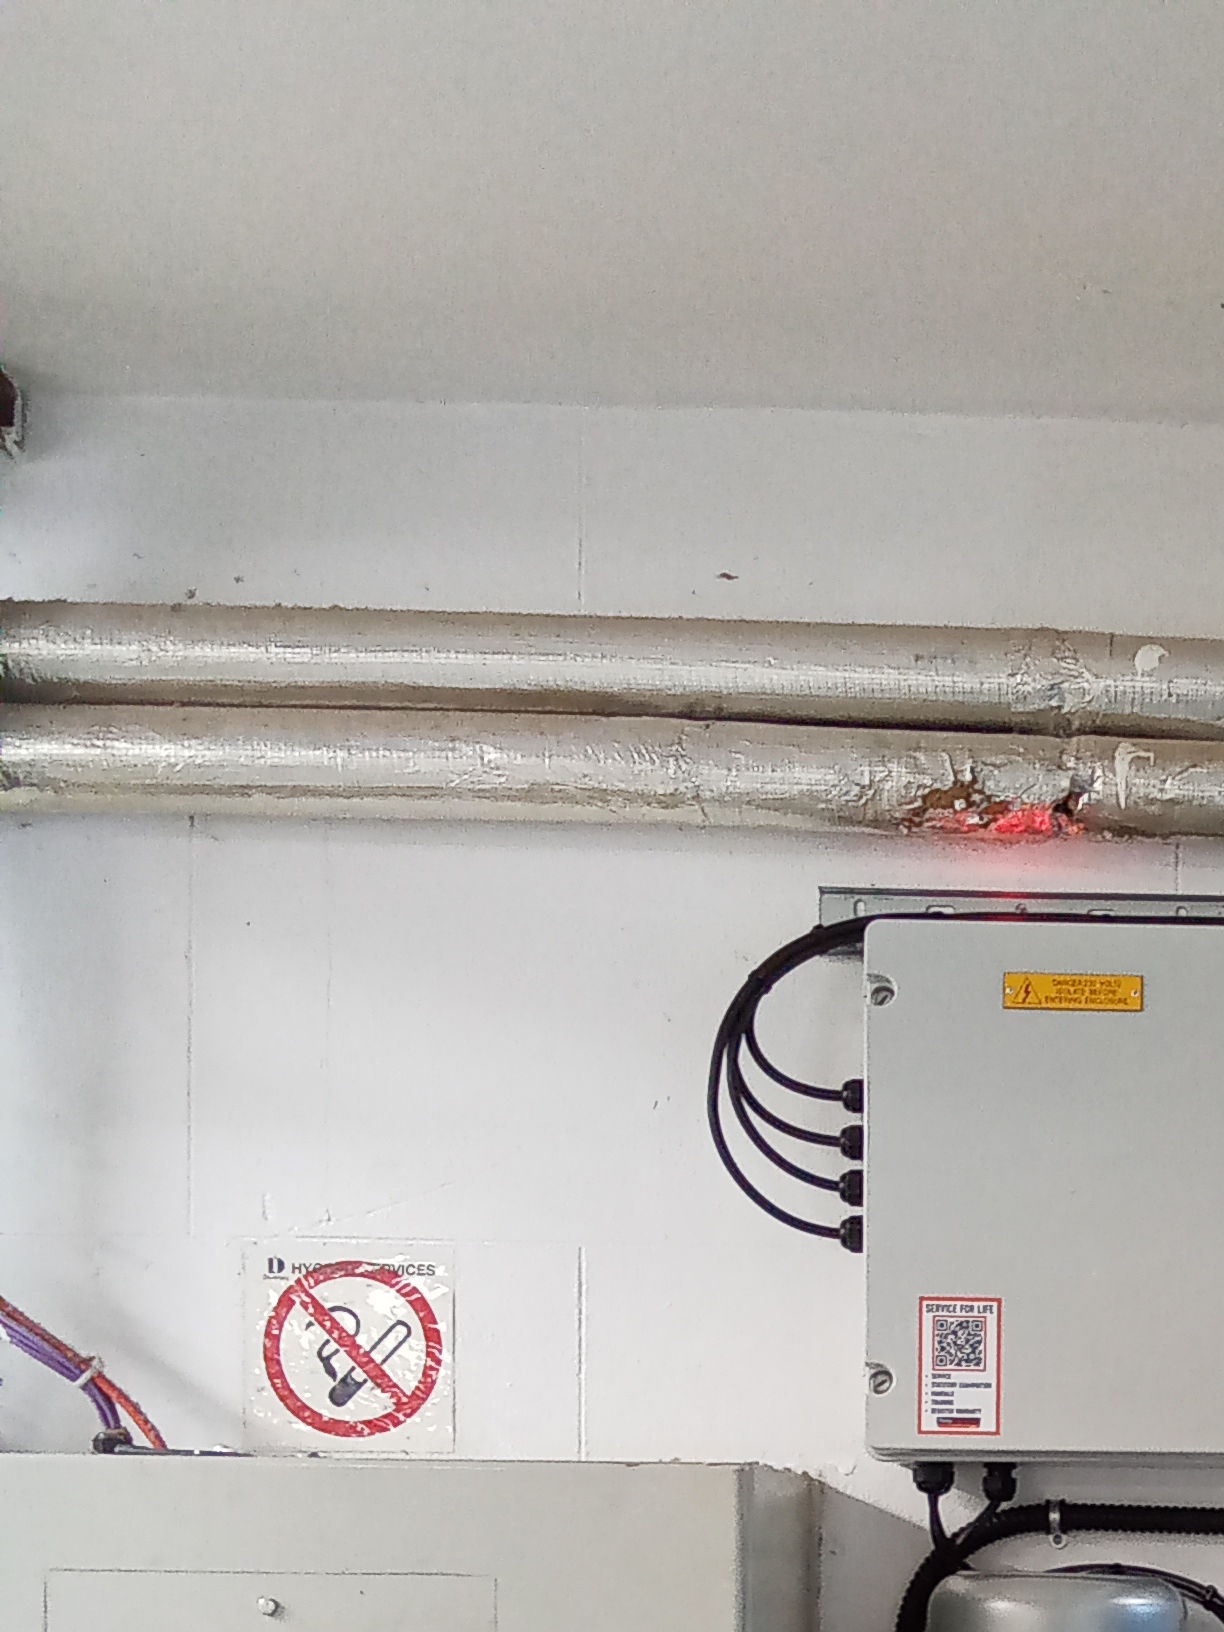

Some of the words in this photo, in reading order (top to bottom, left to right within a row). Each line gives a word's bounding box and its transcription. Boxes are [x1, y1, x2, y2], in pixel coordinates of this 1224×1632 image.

[367, 1263, 436, 1276] RVICES
[925, 1303, 957, 1314] SERVICE
[960, 1304, 975, 1314] FOR
[977, 1304, 994, 1315] LIFE
